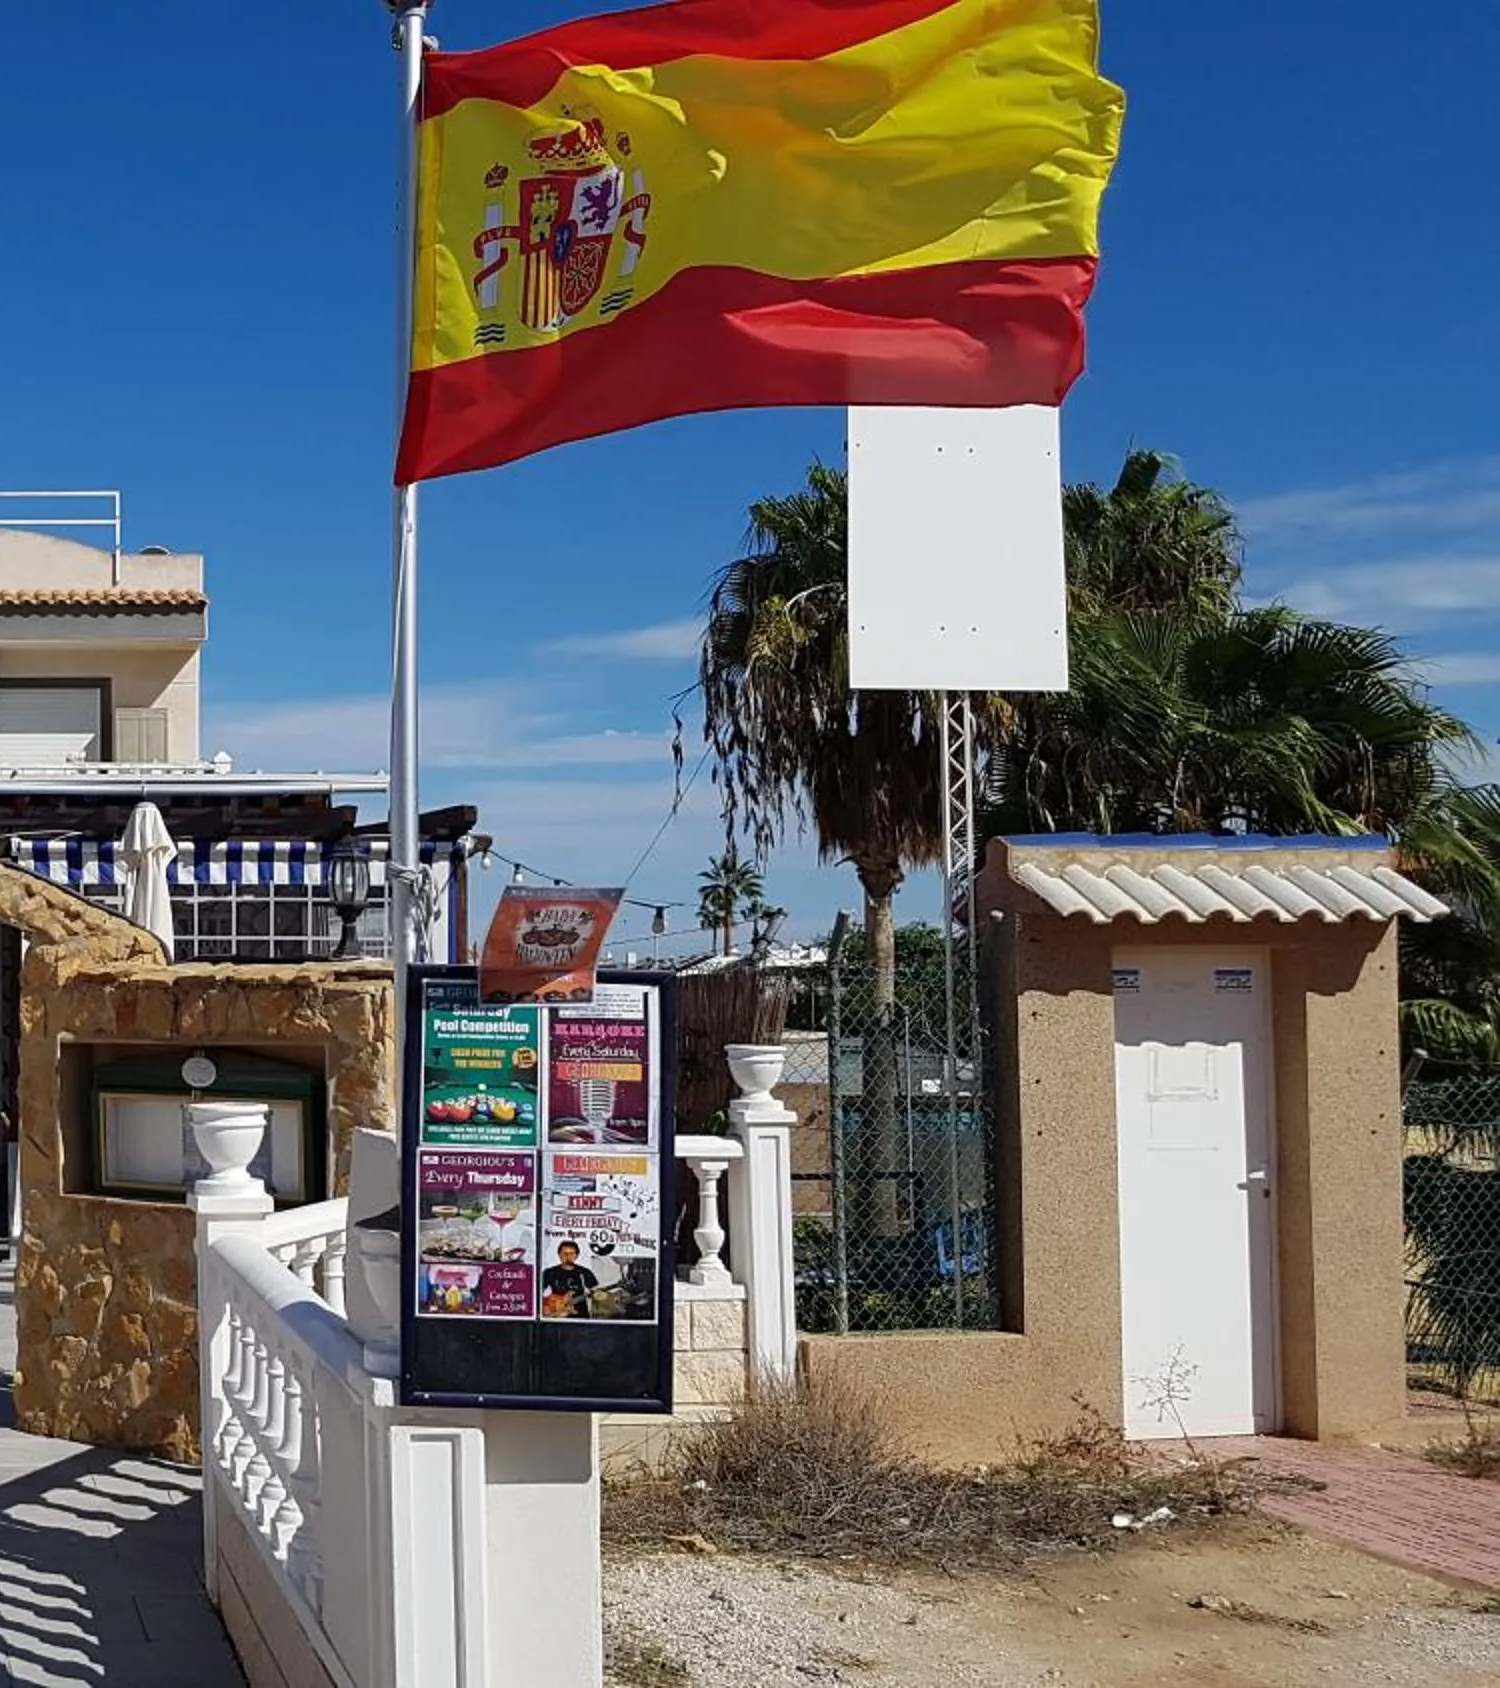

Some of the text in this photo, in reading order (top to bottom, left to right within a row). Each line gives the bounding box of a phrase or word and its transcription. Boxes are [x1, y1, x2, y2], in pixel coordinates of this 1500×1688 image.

[433, 1019, 530, 1034] Pool Competition
[425, 1170, 525, 1189] Every Thursday
